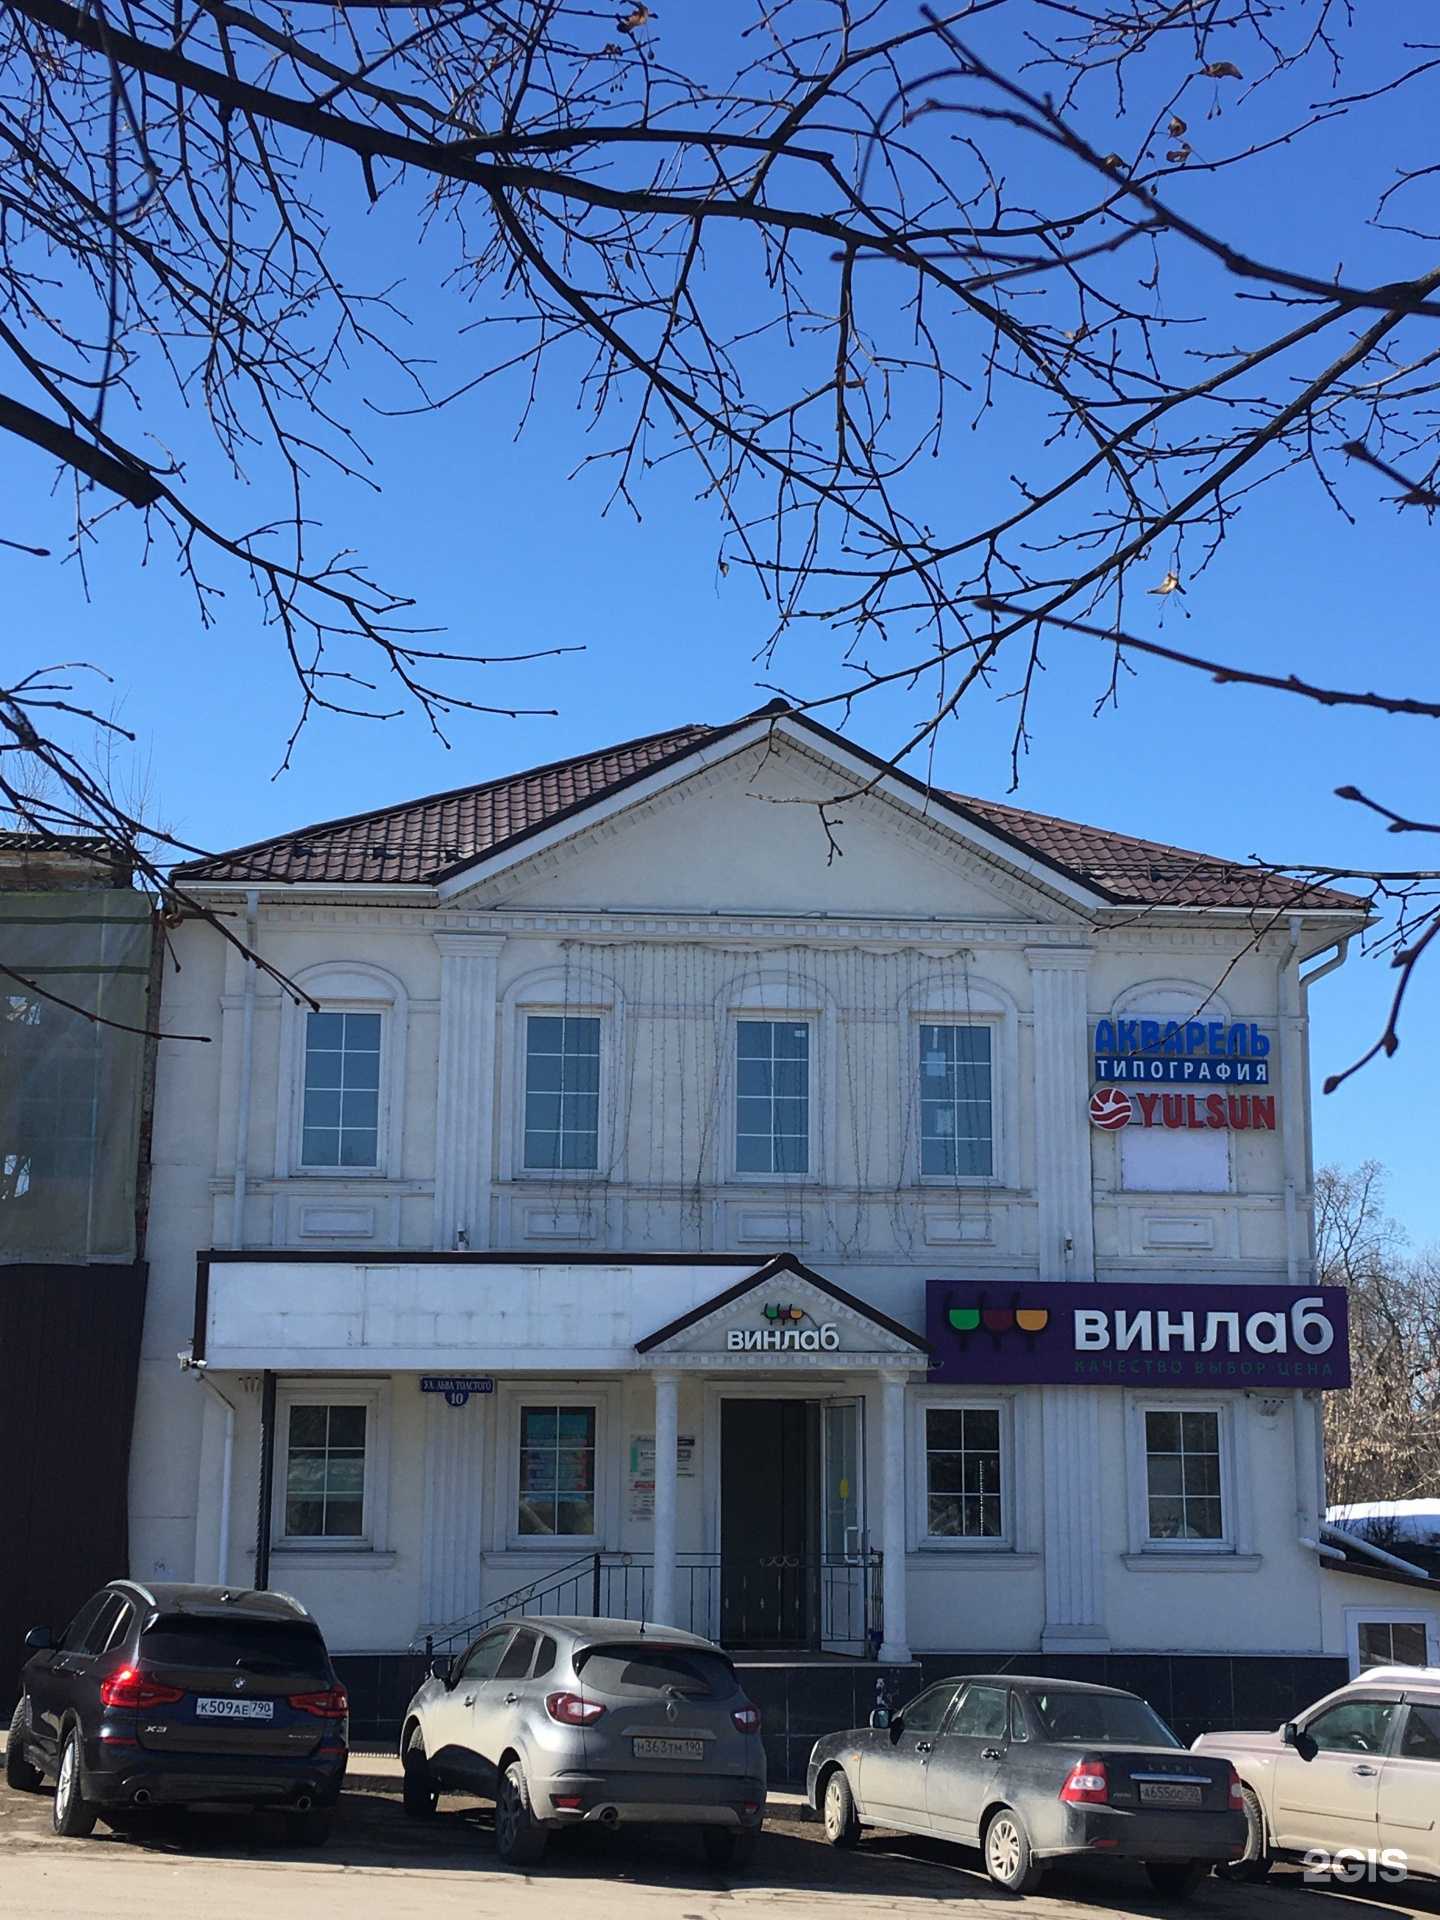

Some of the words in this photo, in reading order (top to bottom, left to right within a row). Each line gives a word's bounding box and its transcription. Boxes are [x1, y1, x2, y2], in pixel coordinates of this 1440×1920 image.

[1095, 1018, 1270, 1057] АКВАРЕЛЬ
[1097, 1060, 1268, 1081] ТИПОГРАФИЯ
[1136, 1092, 1276, 1130] YULSUN
[1074, 1359, 1184, 1375] КАЧЕСТВО
[1195, 1360, 1266, 1376] ВЫБОР
[1279, 1361, 1333, 1377] ЦЕНА
[451, 1392, 464, 1404] 10
